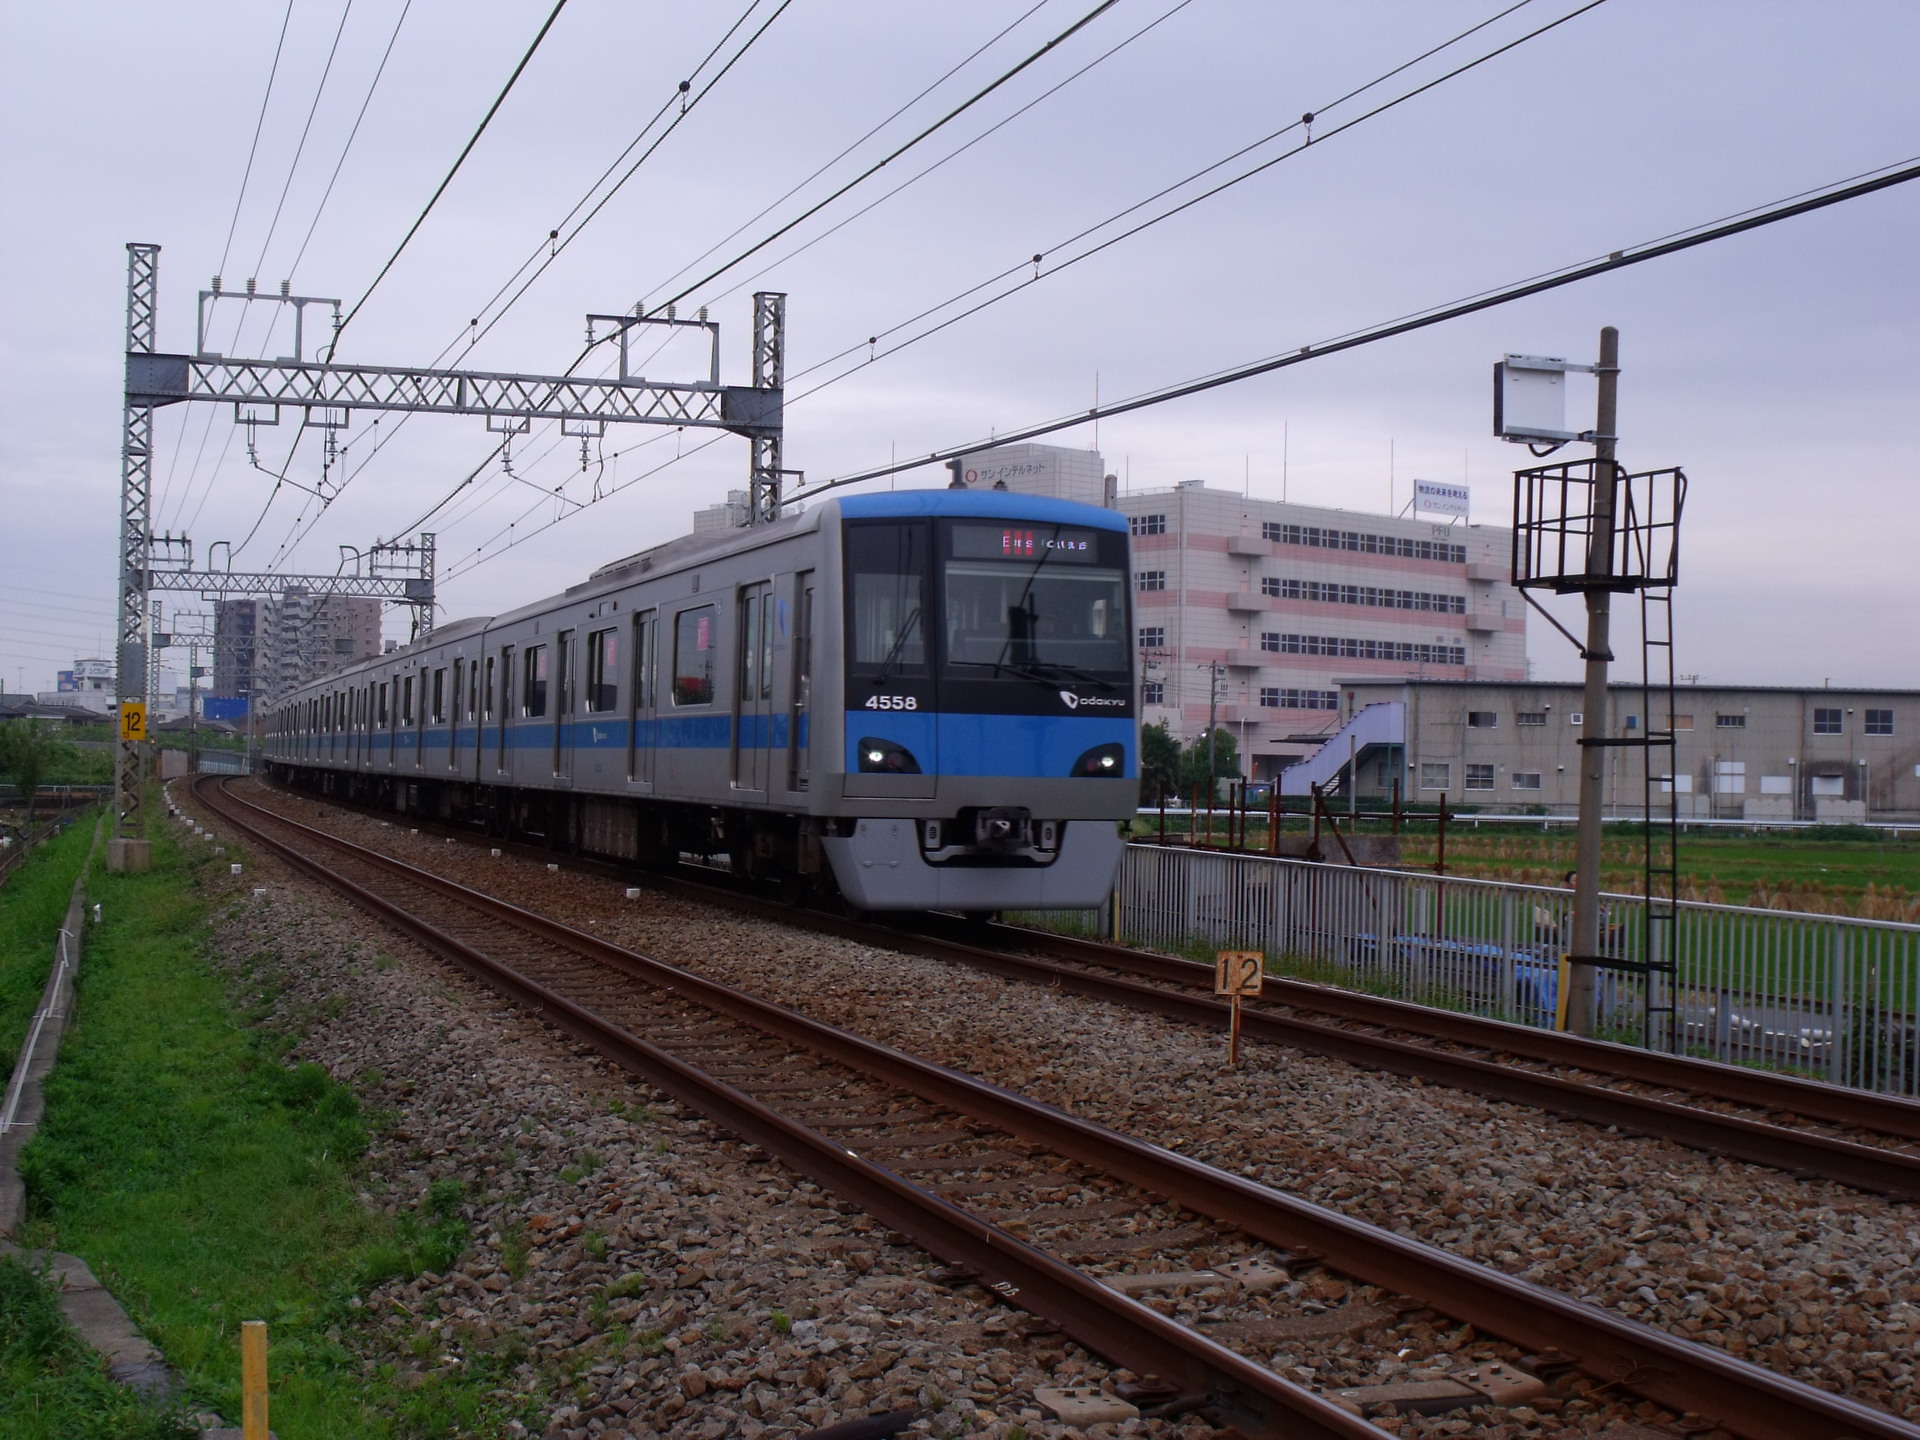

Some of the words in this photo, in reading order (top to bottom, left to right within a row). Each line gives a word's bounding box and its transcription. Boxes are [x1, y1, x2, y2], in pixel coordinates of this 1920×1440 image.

[865, 695, 917, 710] 4558
[125, 711, 141, 731] 12
[1222, 958, 1258, 989] 12
